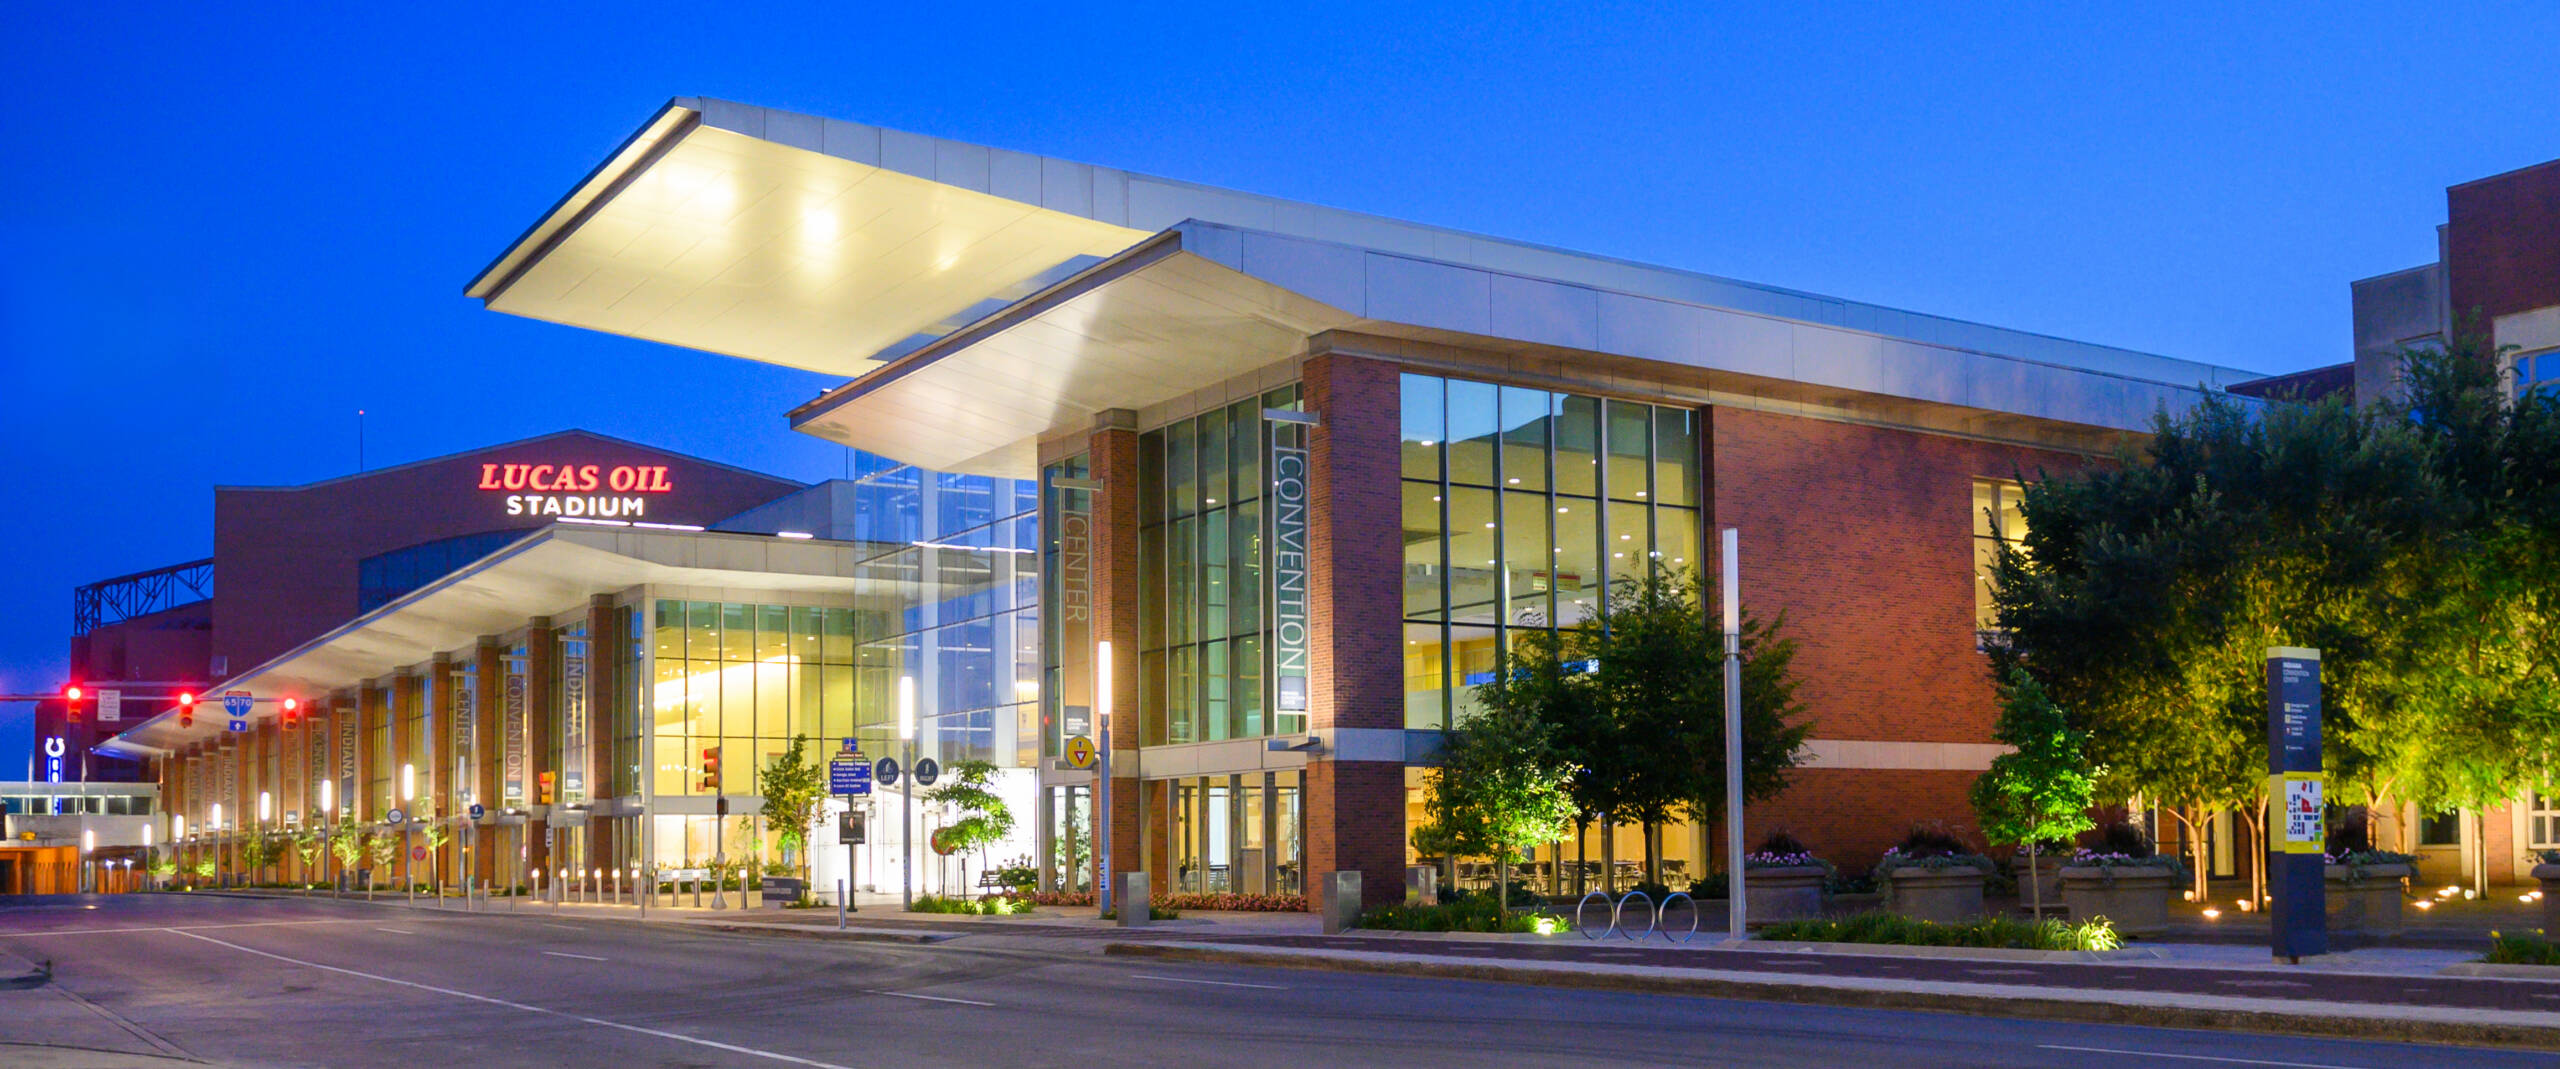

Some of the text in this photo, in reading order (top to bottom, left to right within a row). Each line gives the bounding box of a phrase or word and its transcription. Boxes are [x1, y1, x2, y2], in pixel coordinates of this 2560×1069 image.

[478, 463, 673, 492] LUCAS OIL
[506, 495, 644, 516] STADIUM
[1065, 516, 1089, 621] CENTER
[1279, 455, 1305, 670] CONVENTION
[457, 688, 471, 745] CENTER
[508, 675, 523, 779] CONVENTION
[567, 657, 584, 738] INDIANA
[342, 722, 354, 779] INDIANA
